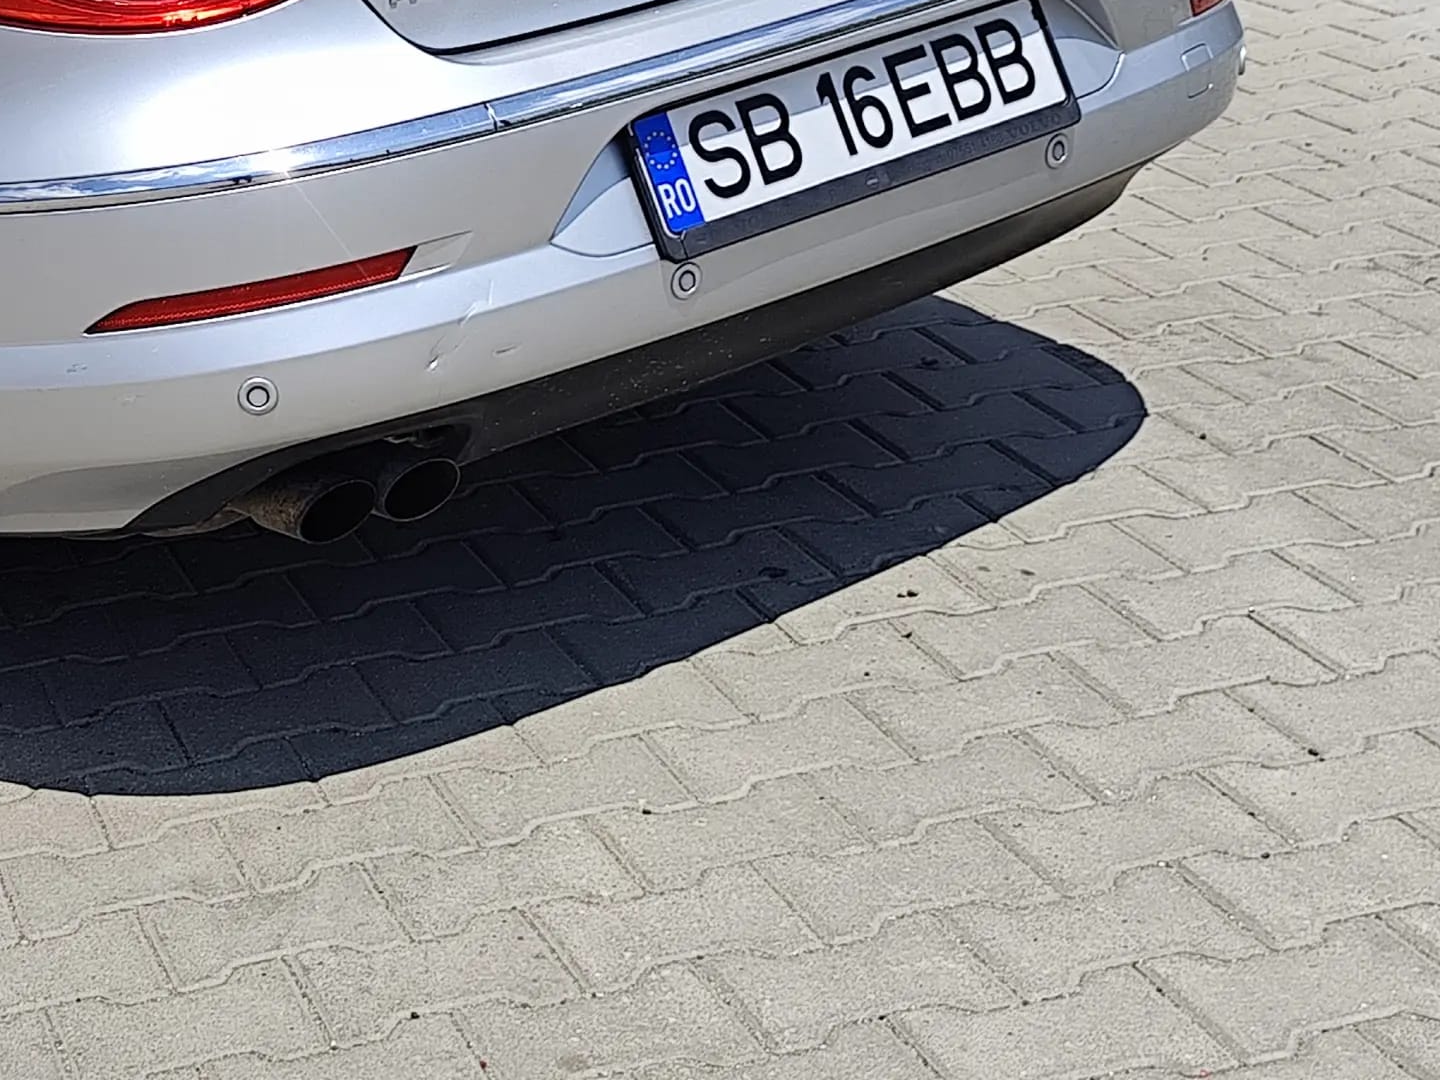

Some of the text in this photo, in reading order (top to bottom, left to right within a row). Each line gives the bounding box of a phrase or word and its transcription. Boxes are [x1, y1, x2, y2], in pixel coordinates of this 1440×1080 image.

[688, 18, 1037, 199] SB 16EBB
[658, 178, 697, 219] RO
